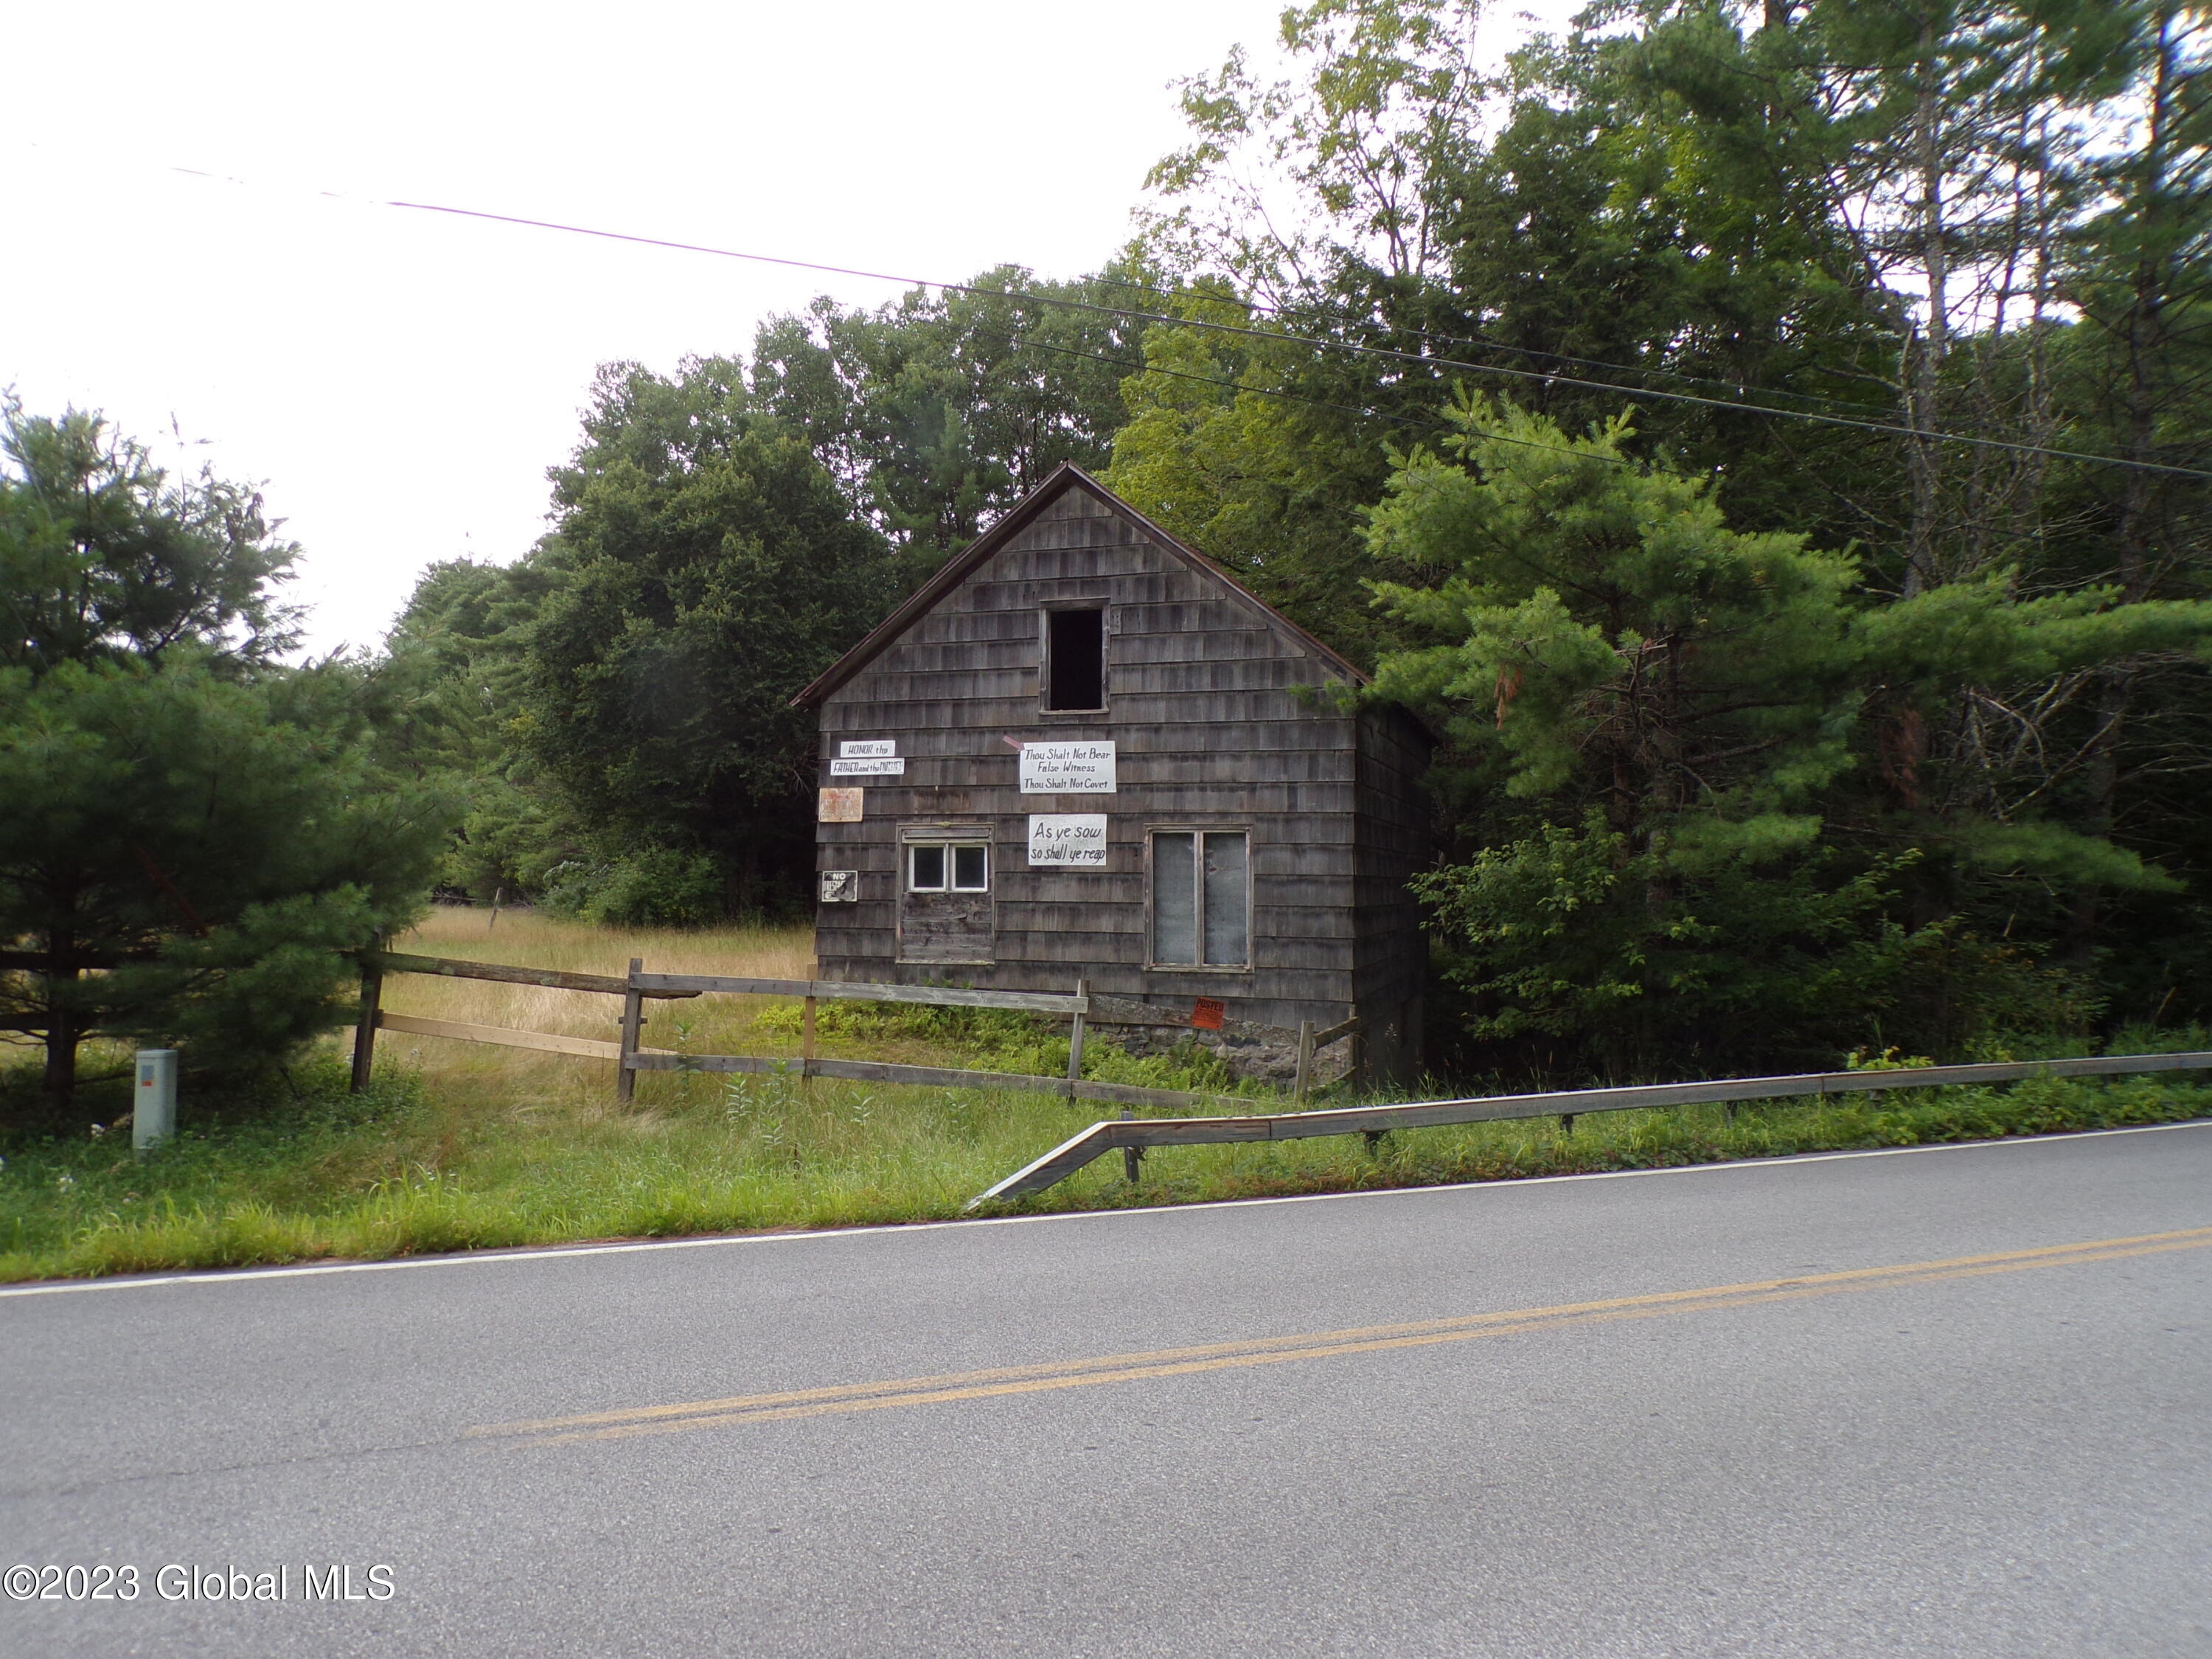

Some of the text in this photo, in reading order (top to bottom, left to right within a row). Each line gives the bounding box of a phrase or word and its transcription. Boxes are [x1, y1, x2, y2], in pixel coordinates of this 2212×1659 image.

[848, 744, 873, 754] HONOR
[1025, 747, 1110, 760] Thou Shalt Not Bear
[834, 762, 859, 773] FATHER
[858, 764, 869, 772] and
[1037, 761, 1096, 772] False Witness
[1024, 778, 1107, 789] Thou Shalt Not Covet
[1033, 822, 1102, 841] As ye sow
[1031, 844, 1105, 864] so shall ye reap
[1197, 998, 1224, 1011] POSTED
